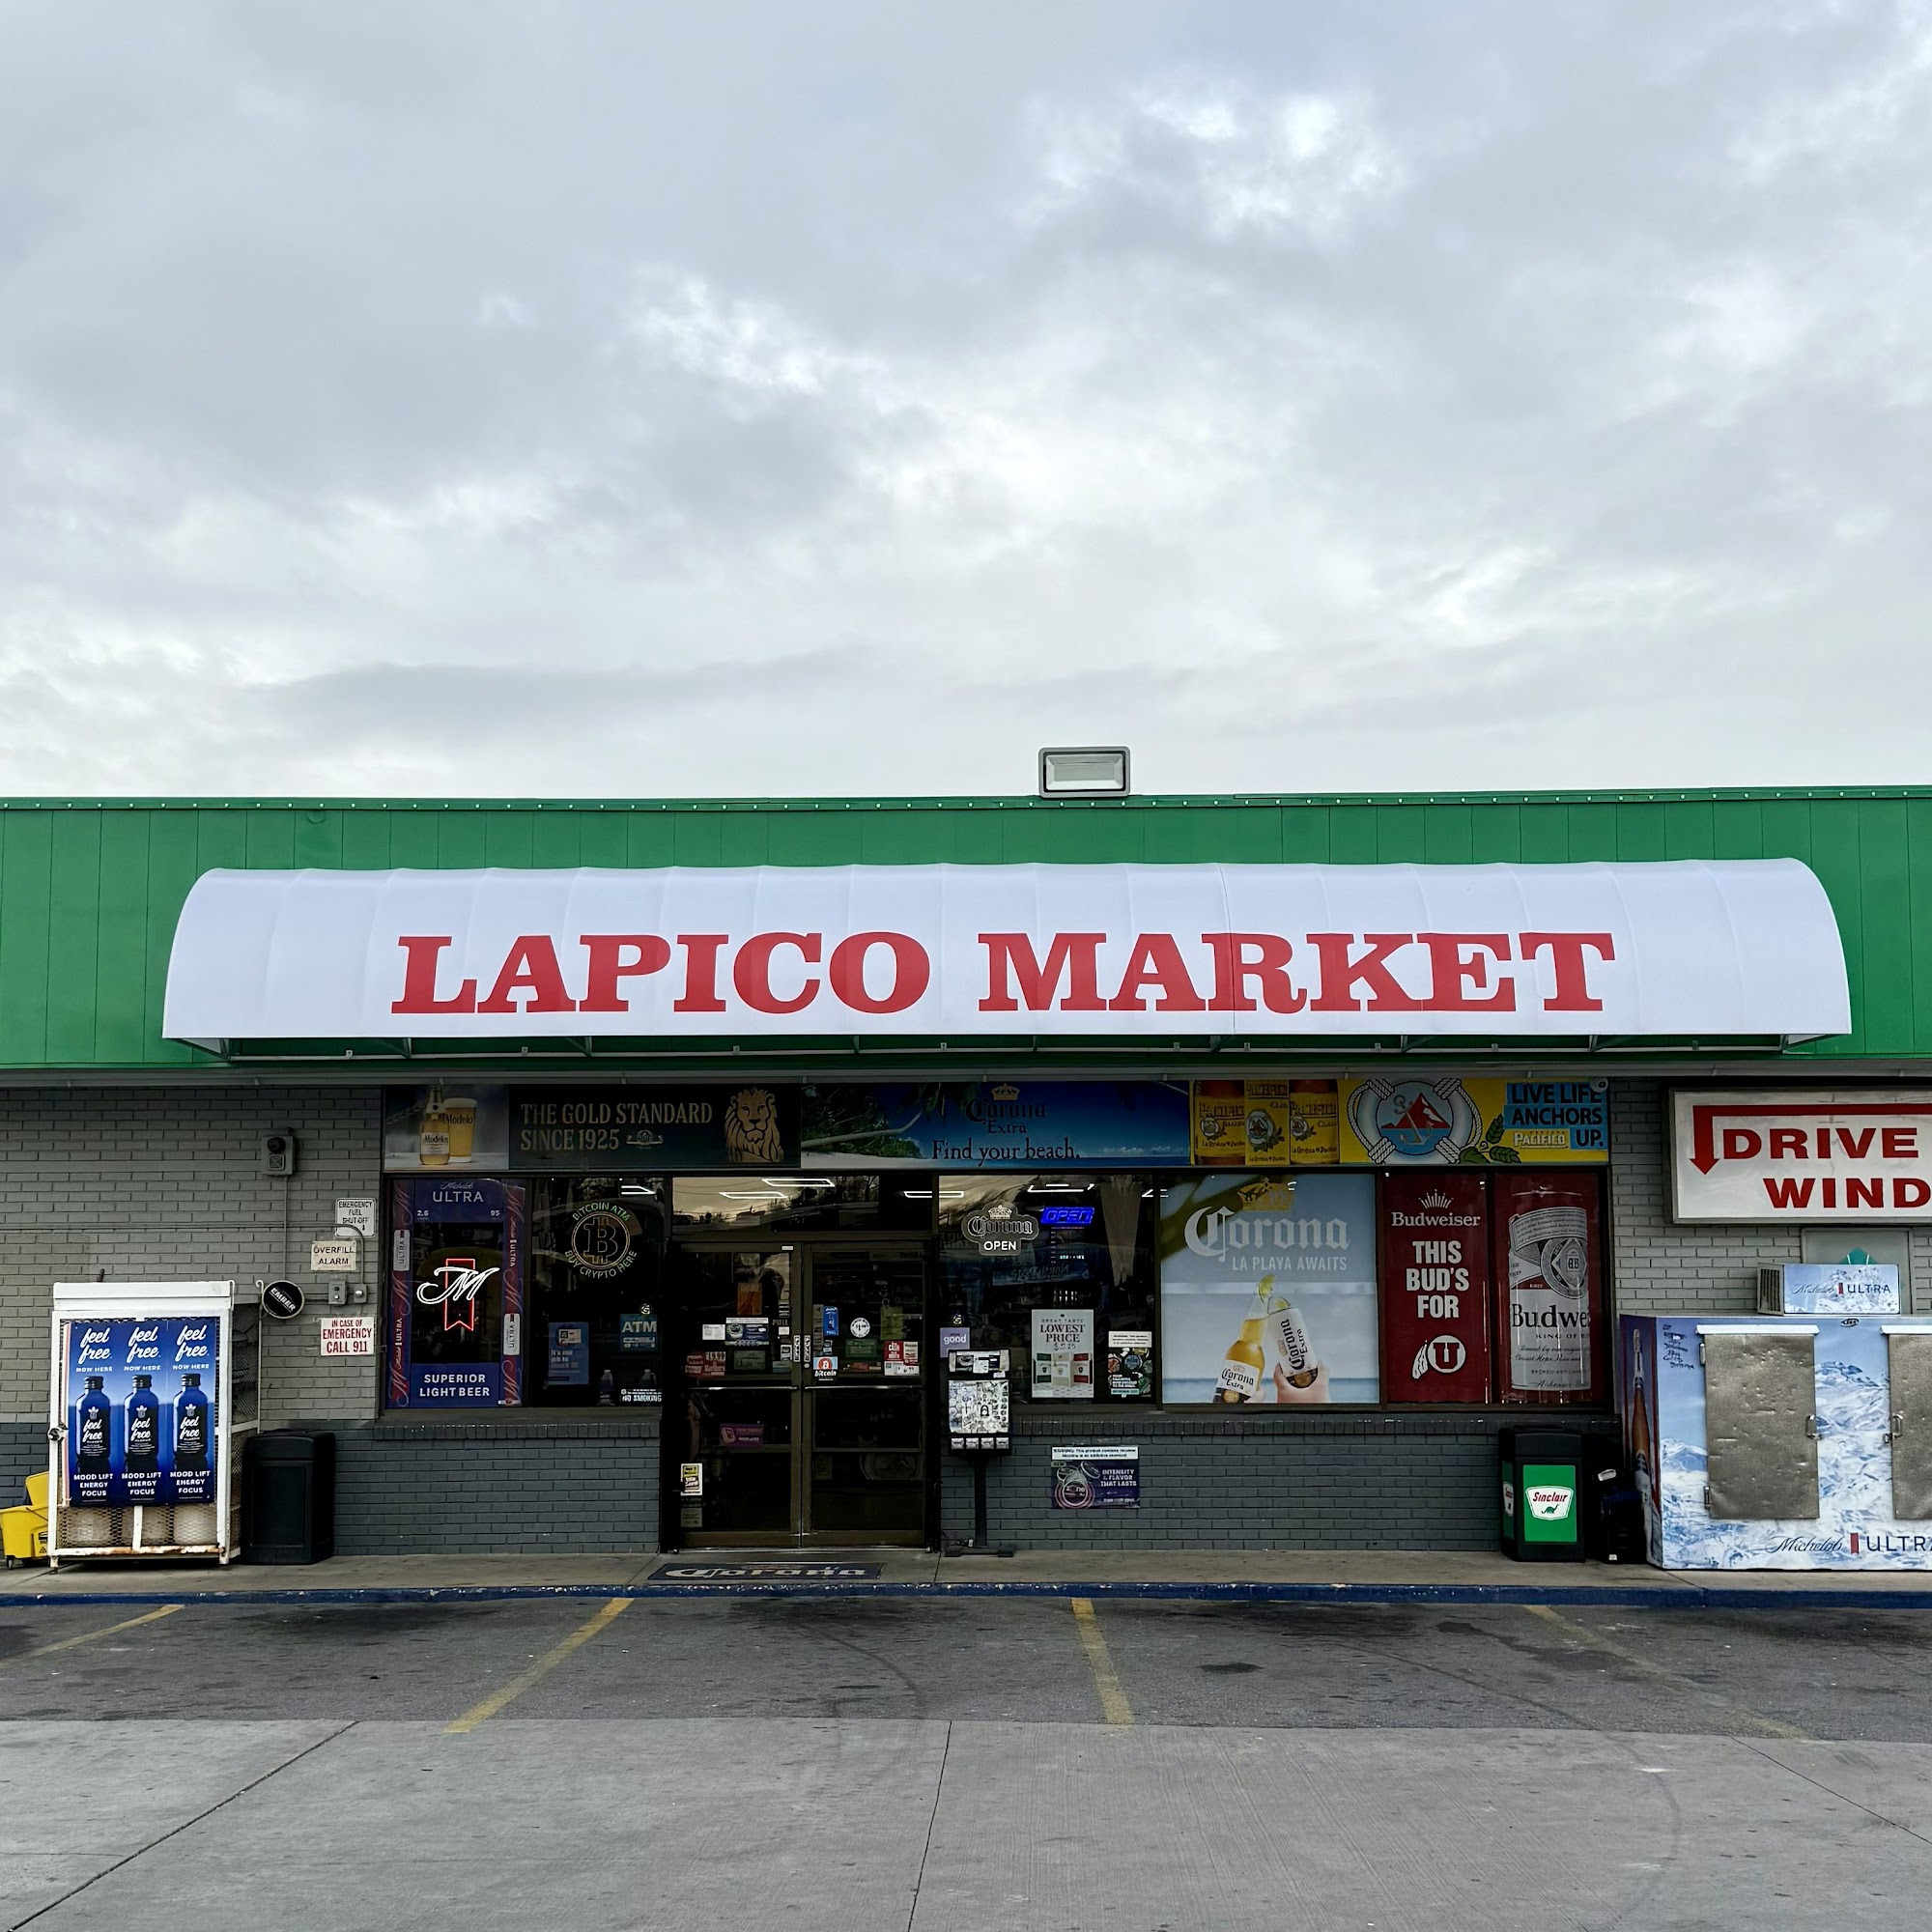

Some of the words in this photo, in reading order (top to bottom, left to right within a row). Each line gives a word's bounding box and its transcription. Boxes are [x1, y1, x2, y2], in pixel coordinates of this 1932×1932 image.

[390, 931, 931, 1014] LAPICO
[978, 932, 1616, 1014] MARKET
[1512, 1083, 1555, 1104] LIVE
[1561, 1083, 1603, 1104] LIFE
[520, 1103, 557, 1124] THE
[562, 1103, 611, 1124] GOLD
[616, 1102, 712, 1124] STANDARD
[967, 1097, 1047, 1124] Corona
[1511, 1107, 1603, 1125] ANCHORS
[988, 1120, 1027, 1133] Extra
[521, 1129, 574, 1151] SINCE
[579, 1129, 620, 1151] 1925
[1514, 1132, 1566, 1147] PACIFICO
[1576, 1130, 1604, 1147] UP.
[1723, 1128, 1919, 1159] DRIVE
[933, 1137, 972, 1159] Find
[978, 1147, 1021, 1167] your
[1025, 1137, 1080, 1159] beach.
[433, 1191, 483, 1202] ULTRA
[1763, 1178, 1932, 1208] WIND
[572, 1202, 609, 1221] BITCOIN
[612, 1205, 630, 1221] ATM
[1046, 1210, 1092, 1221] OPEN
[1391, 1212, 1481, 1227] Budweiser
[967, 1216, 1033, 1238] Corona
[1184, 1206, 1350, 1262] Corona
[984, 1241, 1016, 1251] OPEN
[1412, 1240, 1462, 1264] THIS
[565, 1250, 580, 1267] BUY
[580, 1266, 617, 1279] CRYPTO
[618, 1250, 637, 1273] HERE
[1233, 1258, 1248, 1270] LA
[1252, 1258, 1292, 1270] PLAYA
[1297, 1257, 1347, 1271] AWAITS
[1406, 1267, 1469, 1292] BUD'S
[1847, 1284, 1891, 1293] ULTRA
[271, 1287, 296, 1311] EMBER
[1417, 1295, 1460, 1319] FOR
[1512, 1304, 1590, 1328] Budwe
[177, 1325, 207, 1345] feel
[323, 1328, 372, 1339] EMERGENCY
[621, 1321, 657, 1333] ATM
[1040, 1324, 1085, 1333] LOWEST
[80, 1327, 110, 1348] feel
[128, 1326, 159, 1347] feel
[944, 1335, 966, 1345] good
[1046, 1334, 1080, 1342] PRICE
[1280, 1319, 1305, 1370] Corona
[327, 1342, 349, 1353] CALL
[353, 1341, 368, 1352] 911
[424, 1374, 485, 1383] SUPERIOR
[1222, 1368, 1254, 1385] Corona
[420, 1388, 455, 1396] LIGHT
[459, 1387, 489, 1396] BEER
[83, 1419, 102, 1433] feel
[131, 1418, 150, 1431] feel
[180, 1416, 200, 1429] feel
[1533, 1492, 1568, 1503] Sinclair
[1765, 1536, 1844, 1554] Michelob
[666, 1567, 867, 1579] Corona
